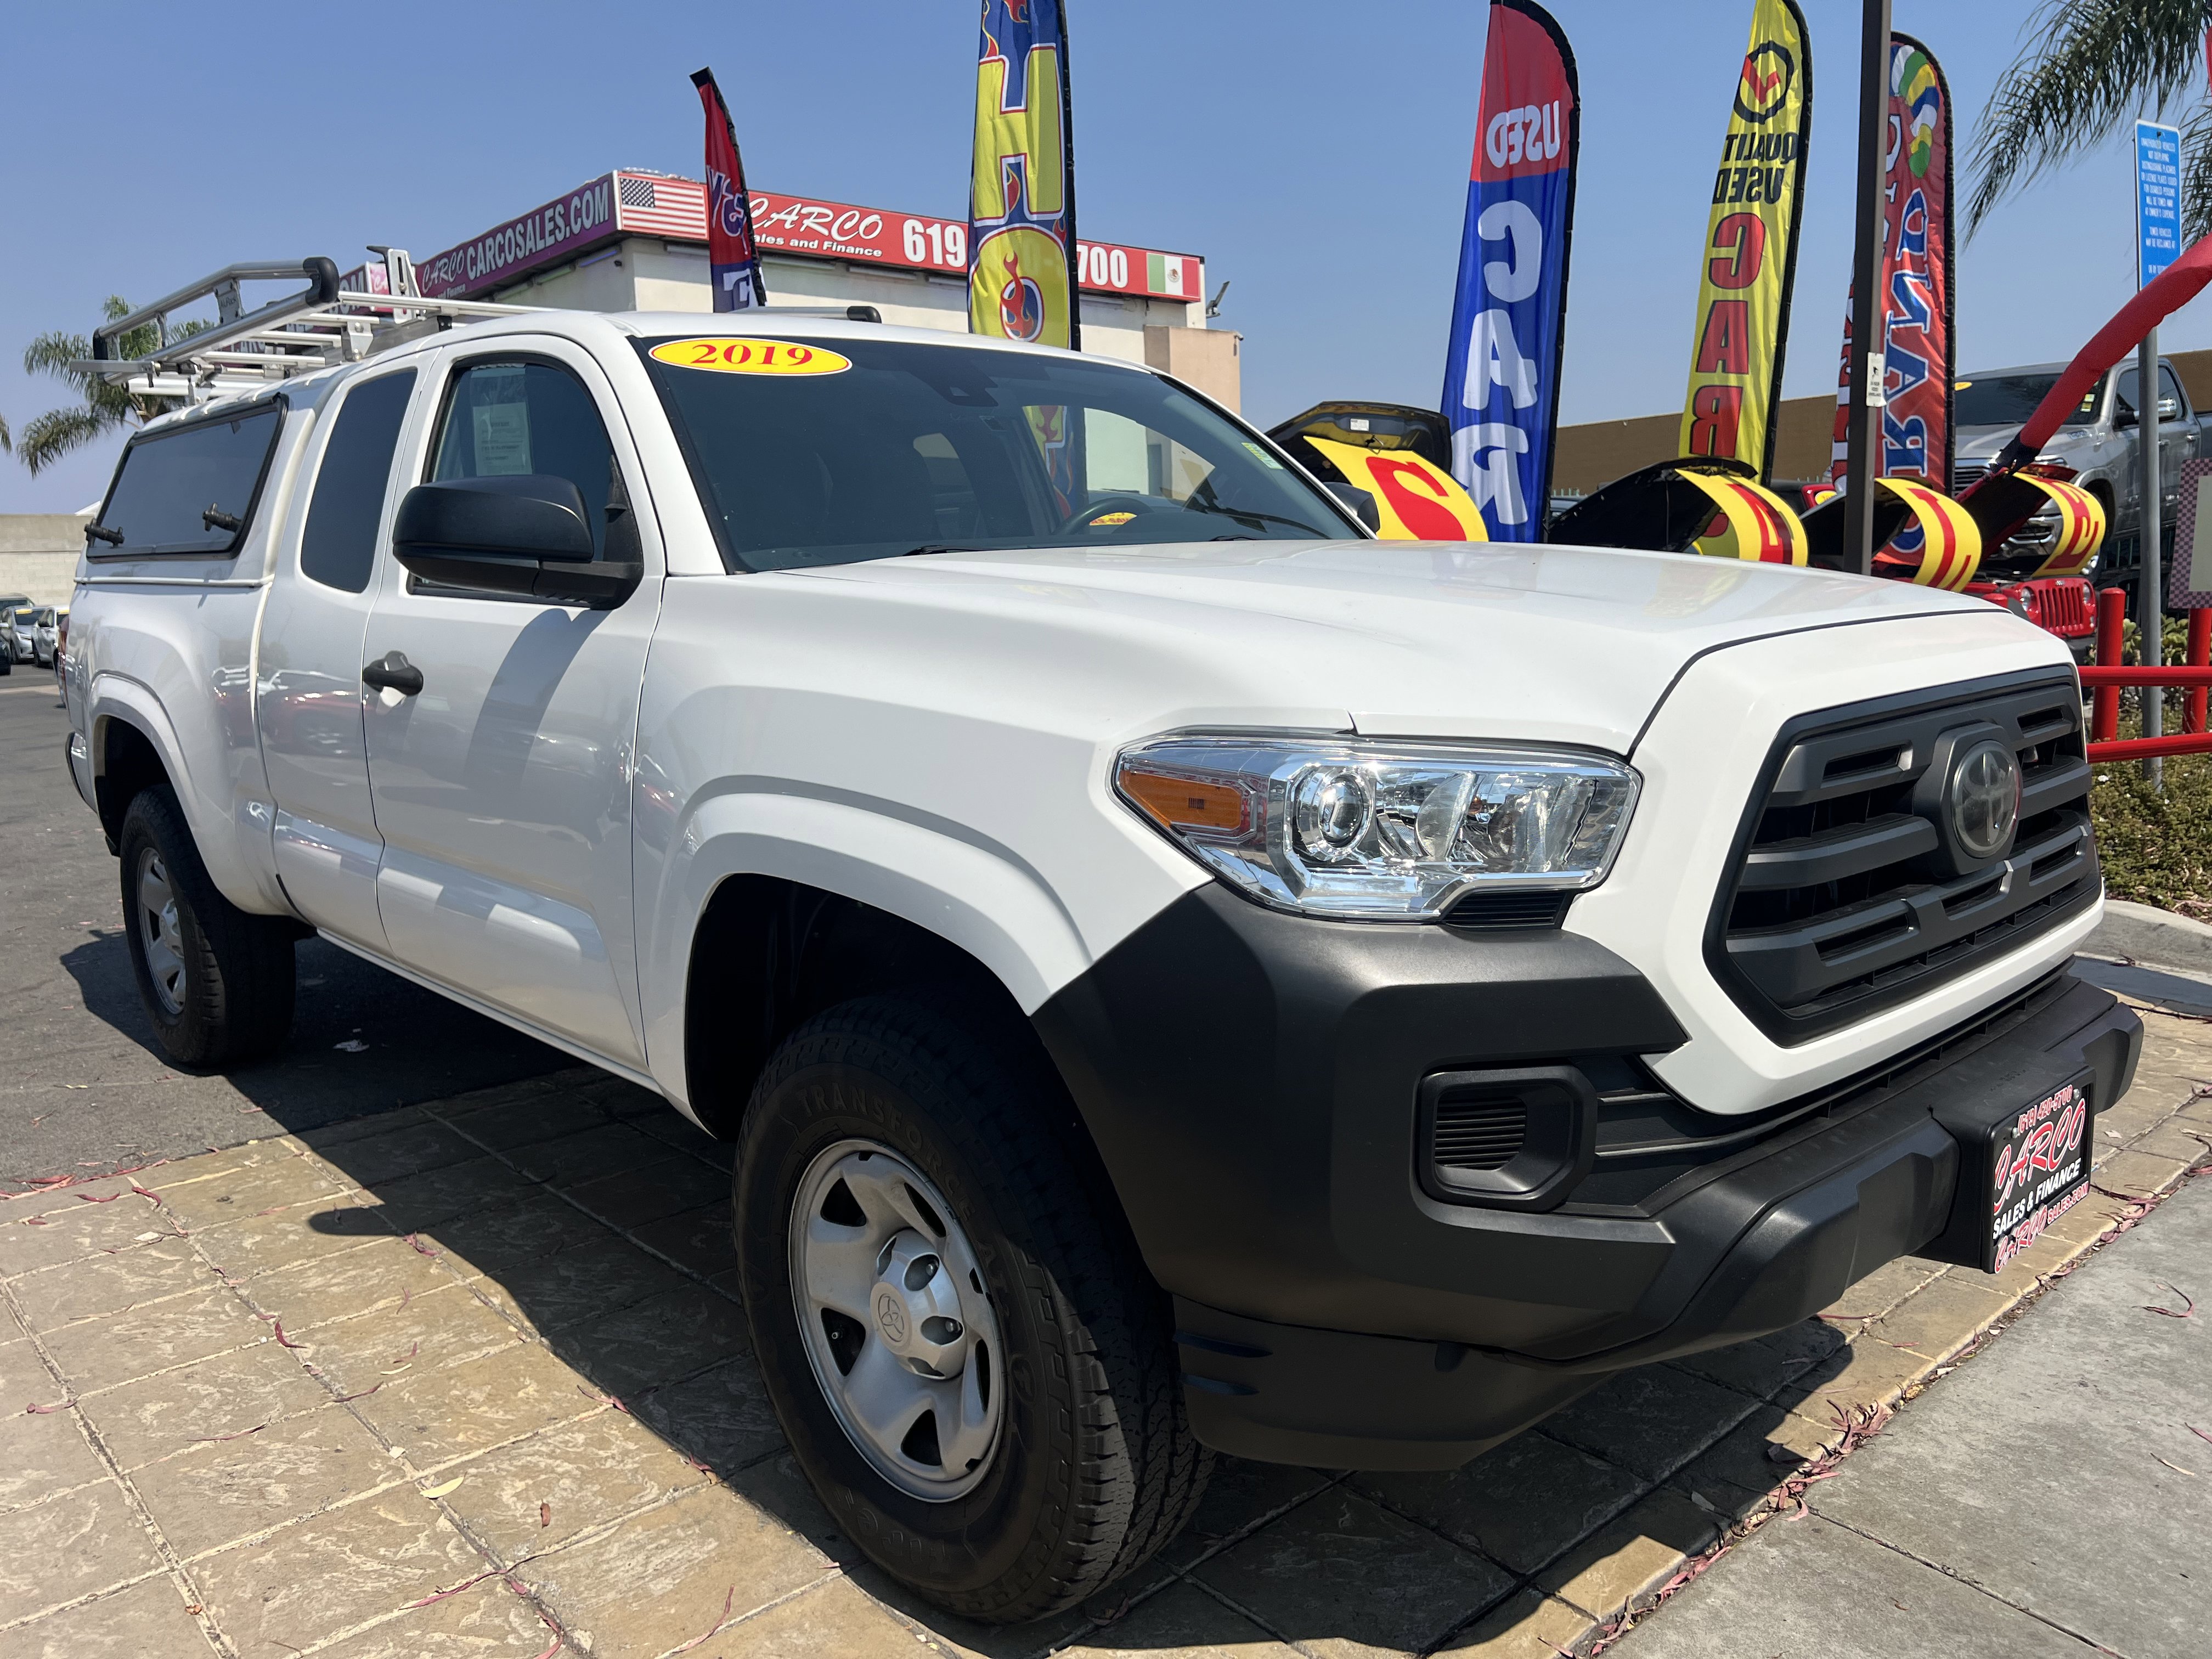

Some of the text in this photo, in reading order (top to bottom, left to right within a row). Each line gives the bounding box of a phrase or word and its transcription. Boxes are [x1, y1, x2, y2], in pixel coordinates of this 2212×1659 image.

[748, 197, 884, 242] CARCO
[902, 218, 967, 268] 619
[968, 43, 1070, 348] HO
[422, 250, 465, 294] CARCO
[467, 181, 609, 281] CARCOSALES.COM
[754, 234, 883, 257] ales and Finance
[690, 344, 812, 366] 2019
[2017, 1084, 2073, 1136] (619) 420-5700
[799, 1082, 976, 1222] TRANSFORCE
[1994, 1098, 2086, 1216] CARCO
[1993, 1158, 2081, 1239] SALES & FINANCE
